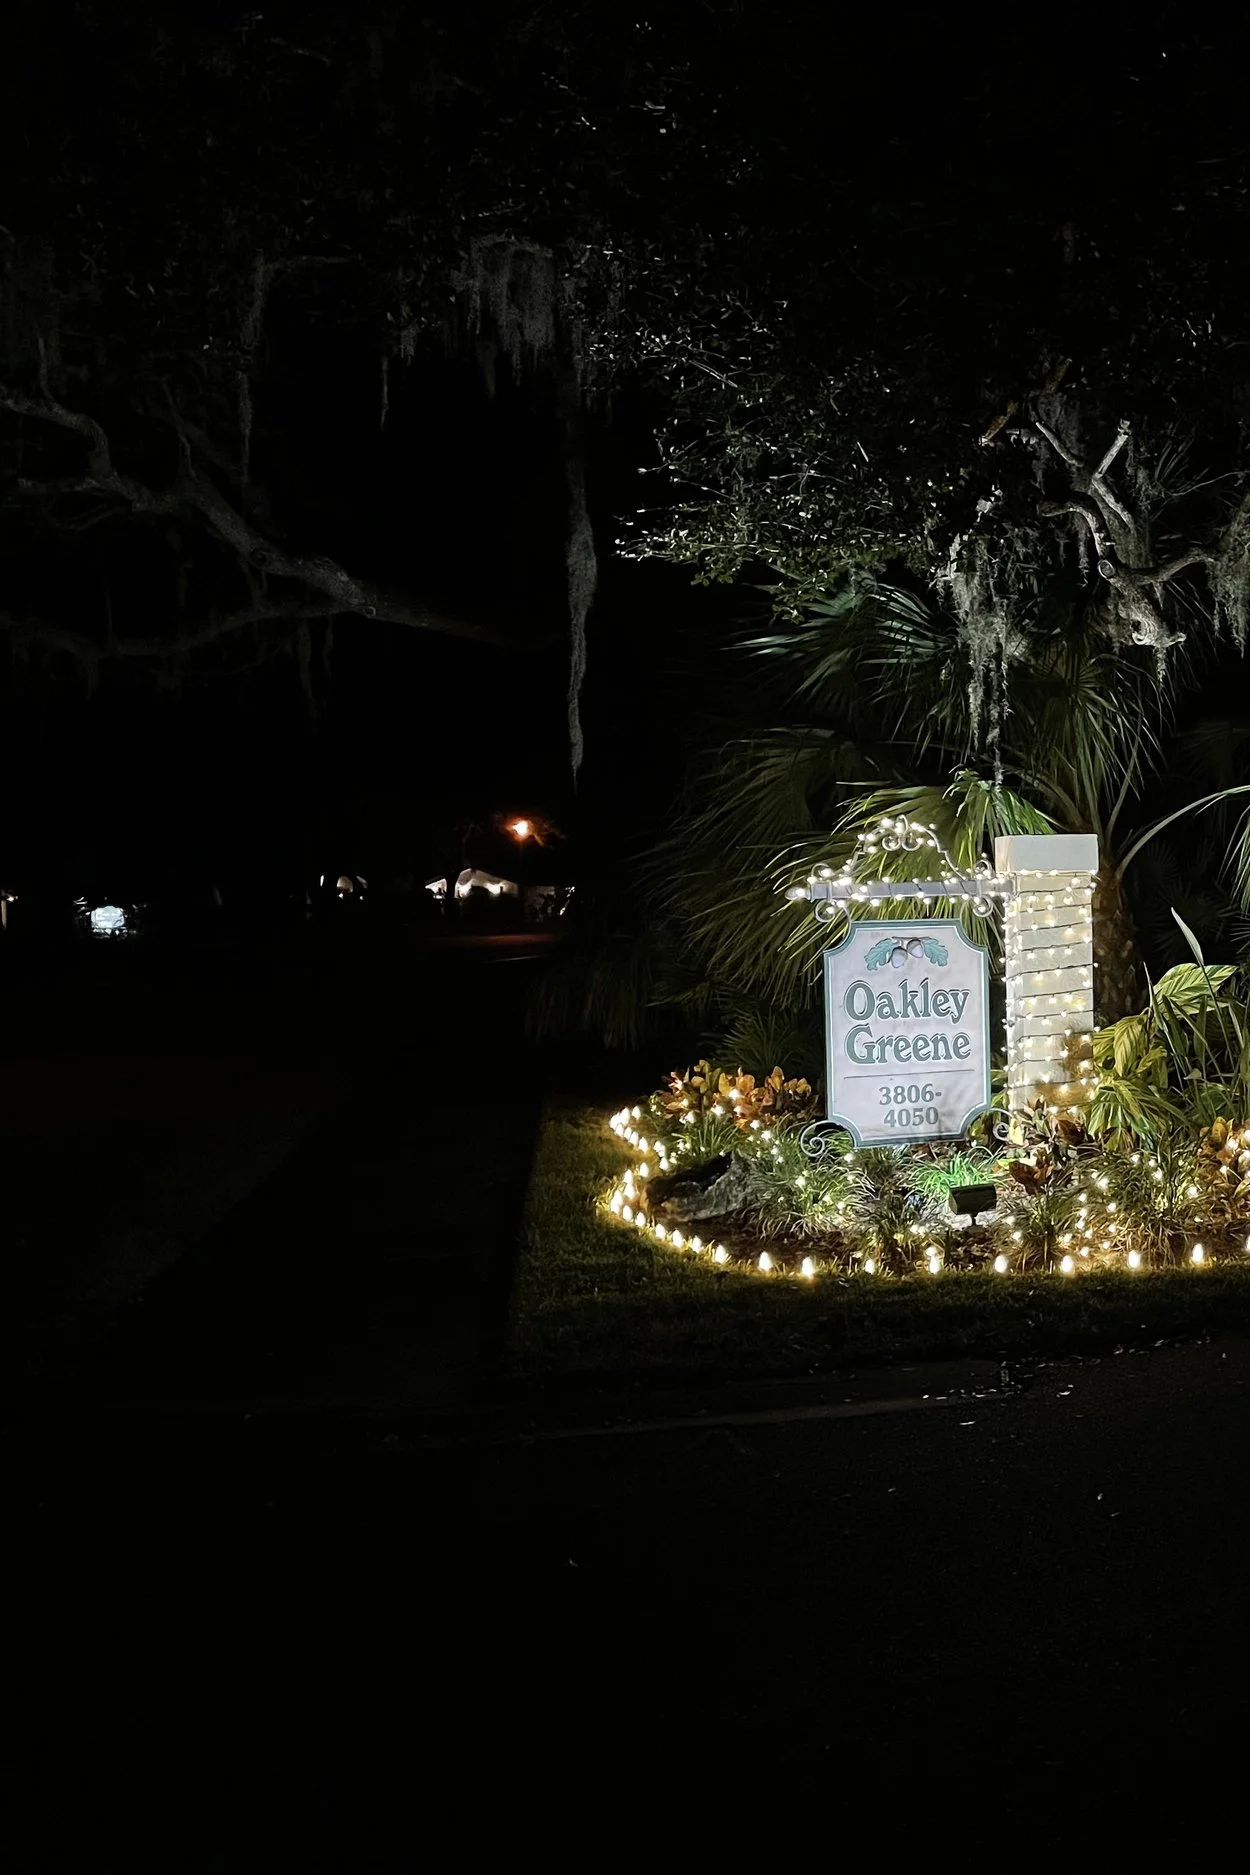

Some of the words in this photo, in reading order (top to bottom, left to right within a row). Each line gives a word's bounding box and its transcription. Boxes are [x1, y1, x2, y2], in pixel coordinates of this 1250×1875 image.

[843, 978, 970, 1023] Oakley
[844, 1023, 971, 1064] Greene
[879, 1083, 942, 1105] 3806-
[884, 1107, 939, 1127] 4050
